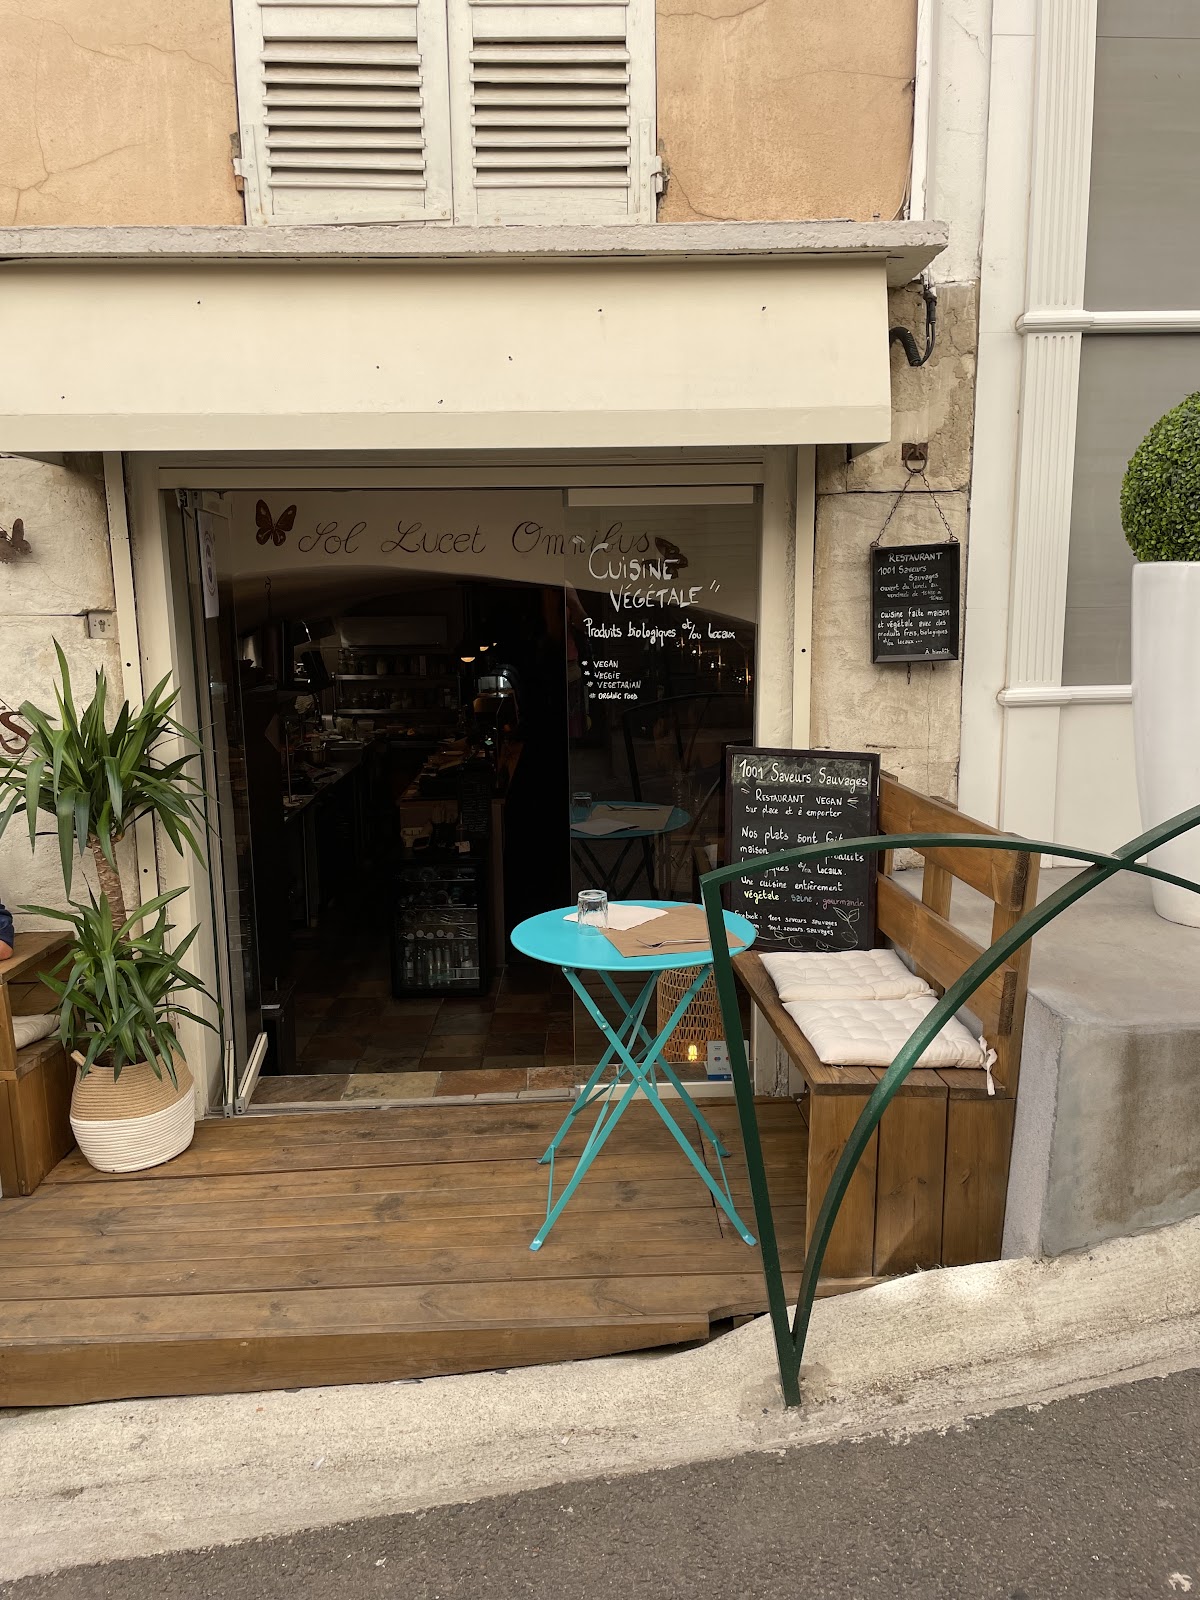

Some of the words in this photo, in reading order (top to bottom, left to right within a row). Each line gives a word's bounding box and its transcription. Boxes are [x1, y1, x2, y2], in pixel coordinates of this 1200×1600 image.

[380, 520, 487, 554] Lucet
[888, 552, 943, 562] RESTAURANT
[877, 566, 896, 576] 1001
[610, 584, 703, 612] VÉGÉTALE
[881, 610, 904, 618] cuisine
[908, 607, 924, 617] faite
[927, 609, 950, 617] maison
[583, 618, 622, 638] Produits
[628, 621, 676, 647] biologiques
[593, 660, 619, 668] VEGAN
[597, 680, 642, 689] VEGETARIAN
[739, 758, 763, 780] 1001
[770, 762, 812, 784] Saveurs
[818, 767, 868, 794] Sauvages
[755, 788, 805, 804] RESTAURANT
[815, 795, 843, 806] VEGAN
[762, 804, 779, 818] place
[785, 806, 794, 815] et
[806, 811, 843, 819] emporter
[741, 826, 758, 839] Nos
[764, 826, 789, 845] plats
[797, 831, 819, 844] sont
[740, 844, 769, 855] maison
[759, 880, 787, 889] cuisine
[794, 880, 843, 892] entièrement
